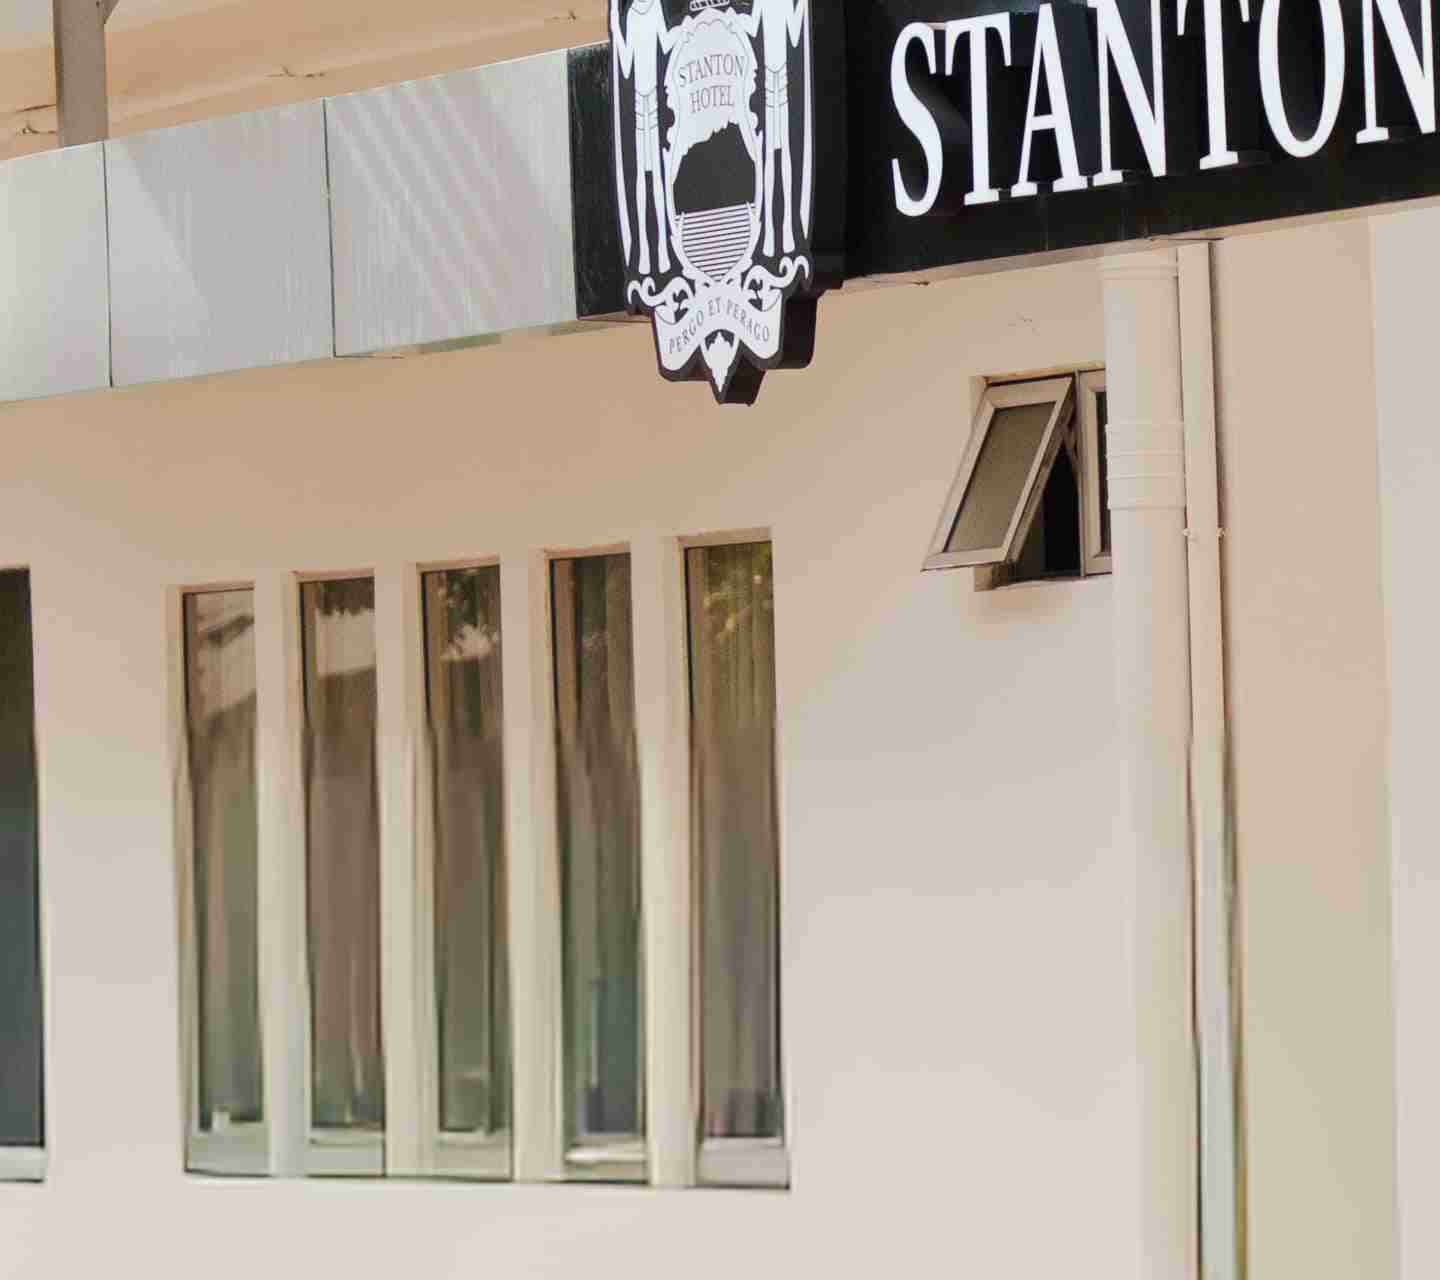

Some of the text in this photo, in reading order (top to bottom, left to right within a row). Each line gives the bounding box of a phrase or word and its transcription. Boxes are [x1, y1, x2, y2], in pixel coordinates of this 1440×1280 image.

[678, 53, 749, 88] STANTON
[688, 84, 735, 113] HOTEL
[666, 296, 770, 354] PERGO ET PERAGO
